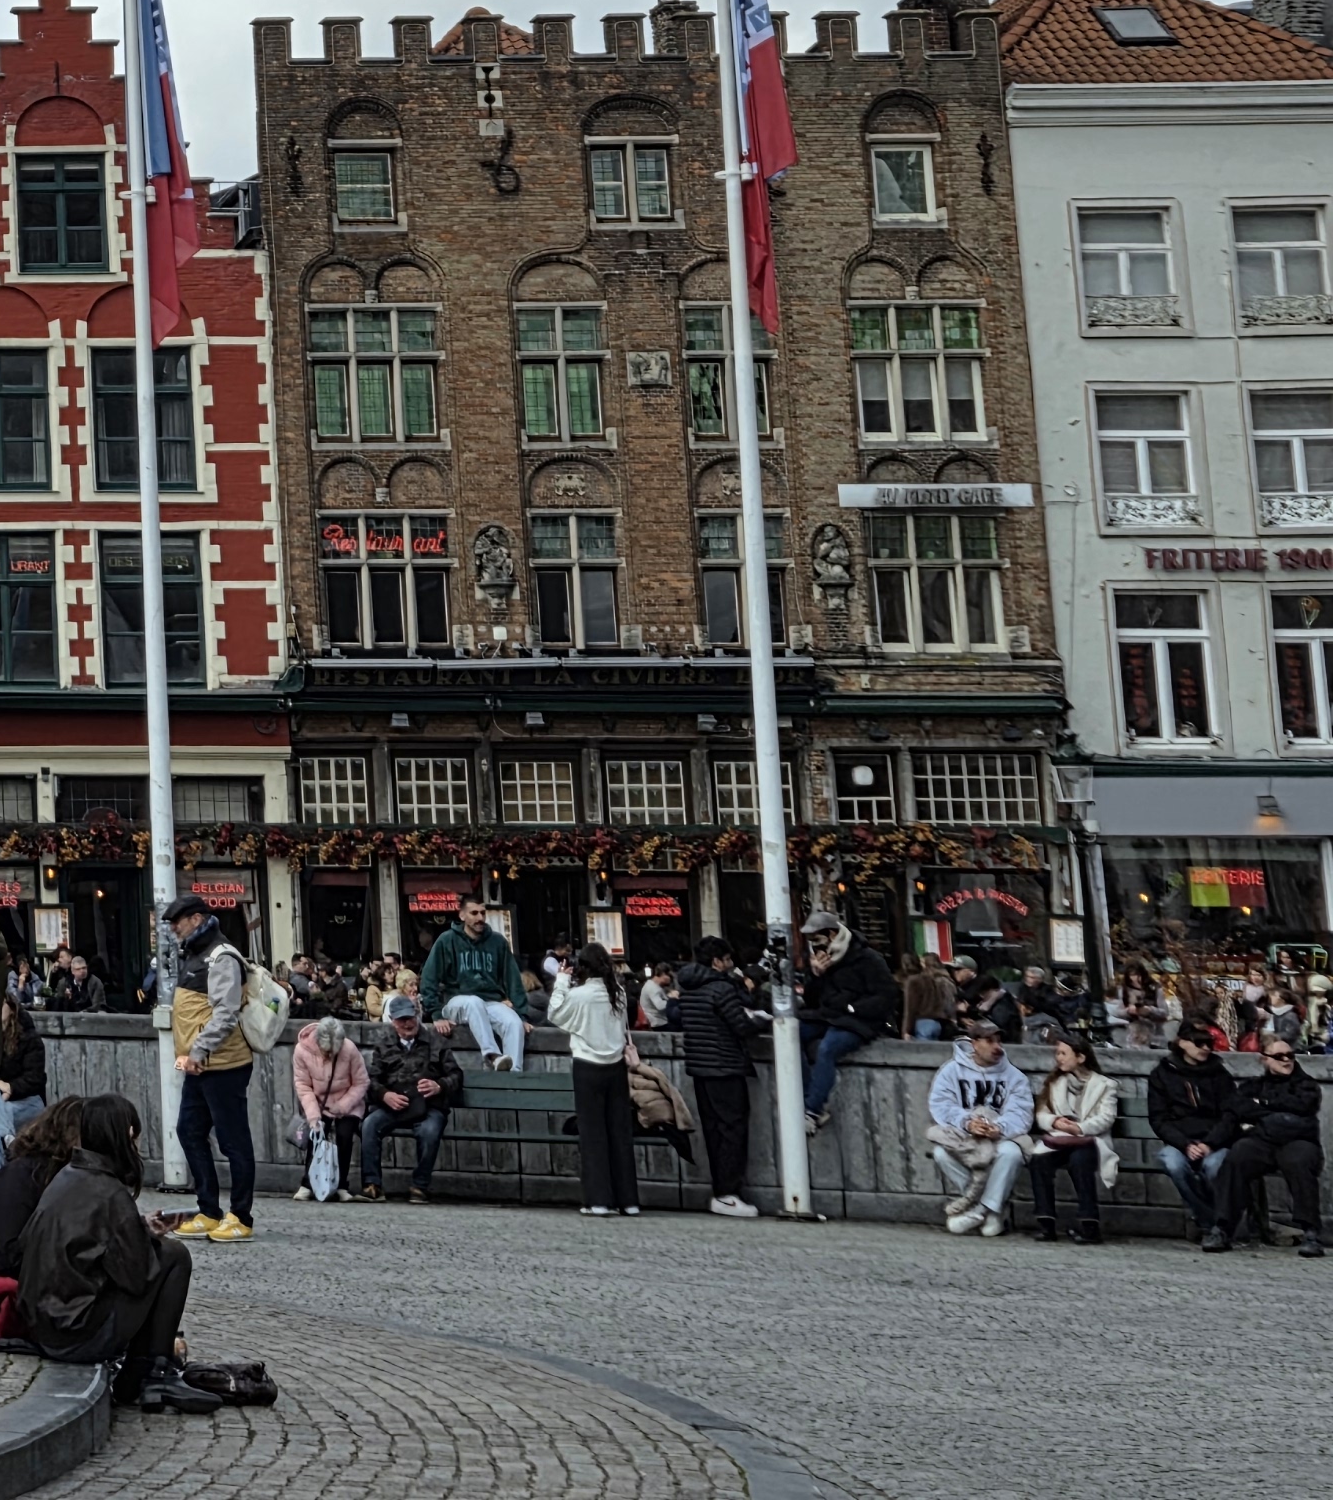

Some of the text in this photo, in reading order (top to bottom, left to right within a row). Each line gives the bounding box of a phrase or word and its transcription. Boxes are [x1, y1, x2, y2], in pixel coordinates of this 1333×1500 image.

[1144, 548, 1268, 572] FRITERIE
[313, 668, 514, 686] RESTAURANT
[191, 882, 245, 895] BELGIAN
